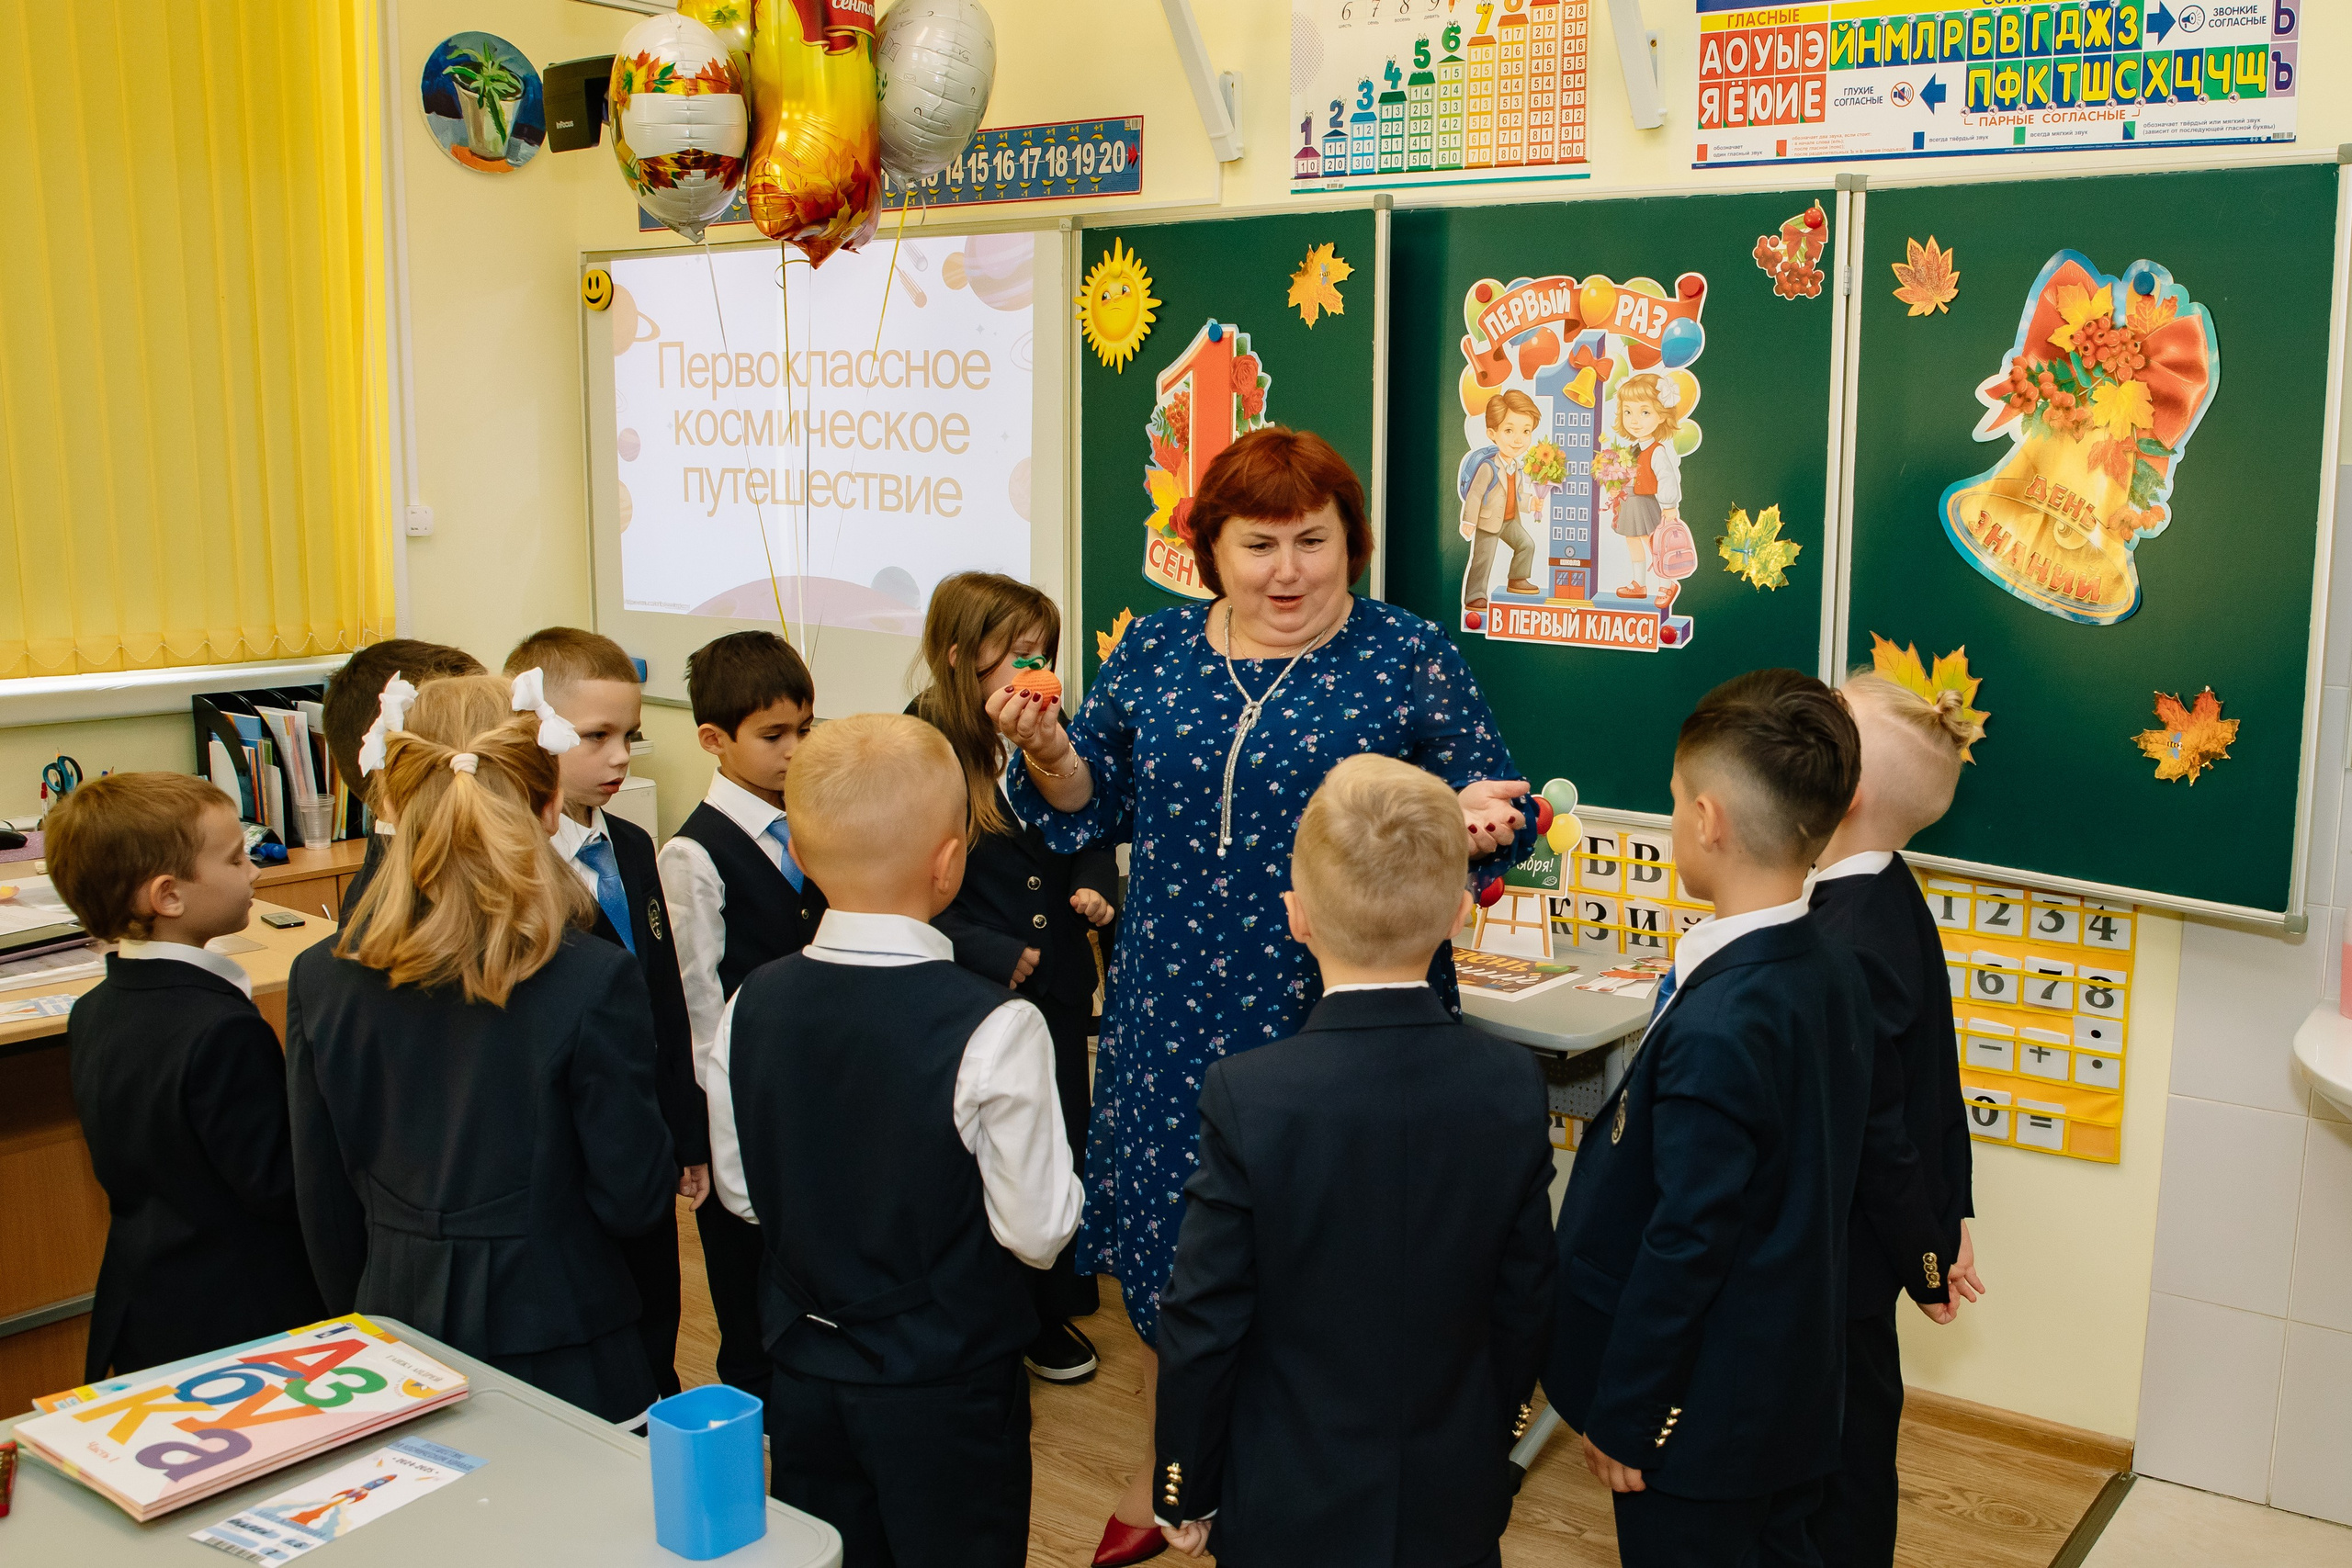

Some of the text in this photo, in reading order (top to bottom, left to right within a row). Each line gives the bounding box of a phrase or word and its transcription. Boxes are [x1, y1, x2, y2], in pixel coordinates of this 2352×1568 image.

[1341, 1, 1353, 20] 6
[1727, 8, 1800, 28] ГЛАСНЫЕ
[2208, 16, 2267, 28] СОГЛАСНЫЕ
[2212, 5, 2257, 17] ЗВОНКИЕ
[1356, 80, 1374, 111] 3
[1834, 96, 1883, 107] СОГЛАСНЫЕ
[1843, 85, 1874, 96] ГЛУХИЕ
[1329, 99, 1344, 128] 2
[1979, 109, 2126, 127] ПАРНЫЕ СОГЛАСНЫЕ
[2179, 125, 2224, 133] последующей
[2252, 123, 2276, 131] буквы)
[2180, 119, 2208, 128] твёрдый
[2222, 118, 2245, 126] мягкий
[945, 153, 964, 185] 14
[967, 152, 989, 183] 15
[992, 150, 1015, 181] 16
[1019, 147, 1042, 179] 17
[1045, 145, 1068, 177] 18
[1071, 142, 1095, 175] 19
[1099, 140, 1126, 174] 20
[1483, 282, 1668, 340] ПЕРВЫЙ РАЗ
[657, 341, 991, 401] Первоклассное
[673, 408, 971, 455] космическое
[683, 465, 964, 519] путешествие
[2024, 473, 2098, 531] ДЕНЬ
[1149, 539, 1203, 588] СЕН
[1968, 510, 2103, 604] ЗНАНИЙ
[1491, 606, 1654, 645] В ПЕРВЫЙ КЛАСС!
[1517, 853, 1554, 877] ября!
[1585, 835, 1662, 883] Б В
[1585, 900, 1609, 941] З
[1625, 907, 1663, 948] И
[1939, 889, 2118, 942] 1 2 3 4
[1976, 963, 2114, 1009] 6 7 8
